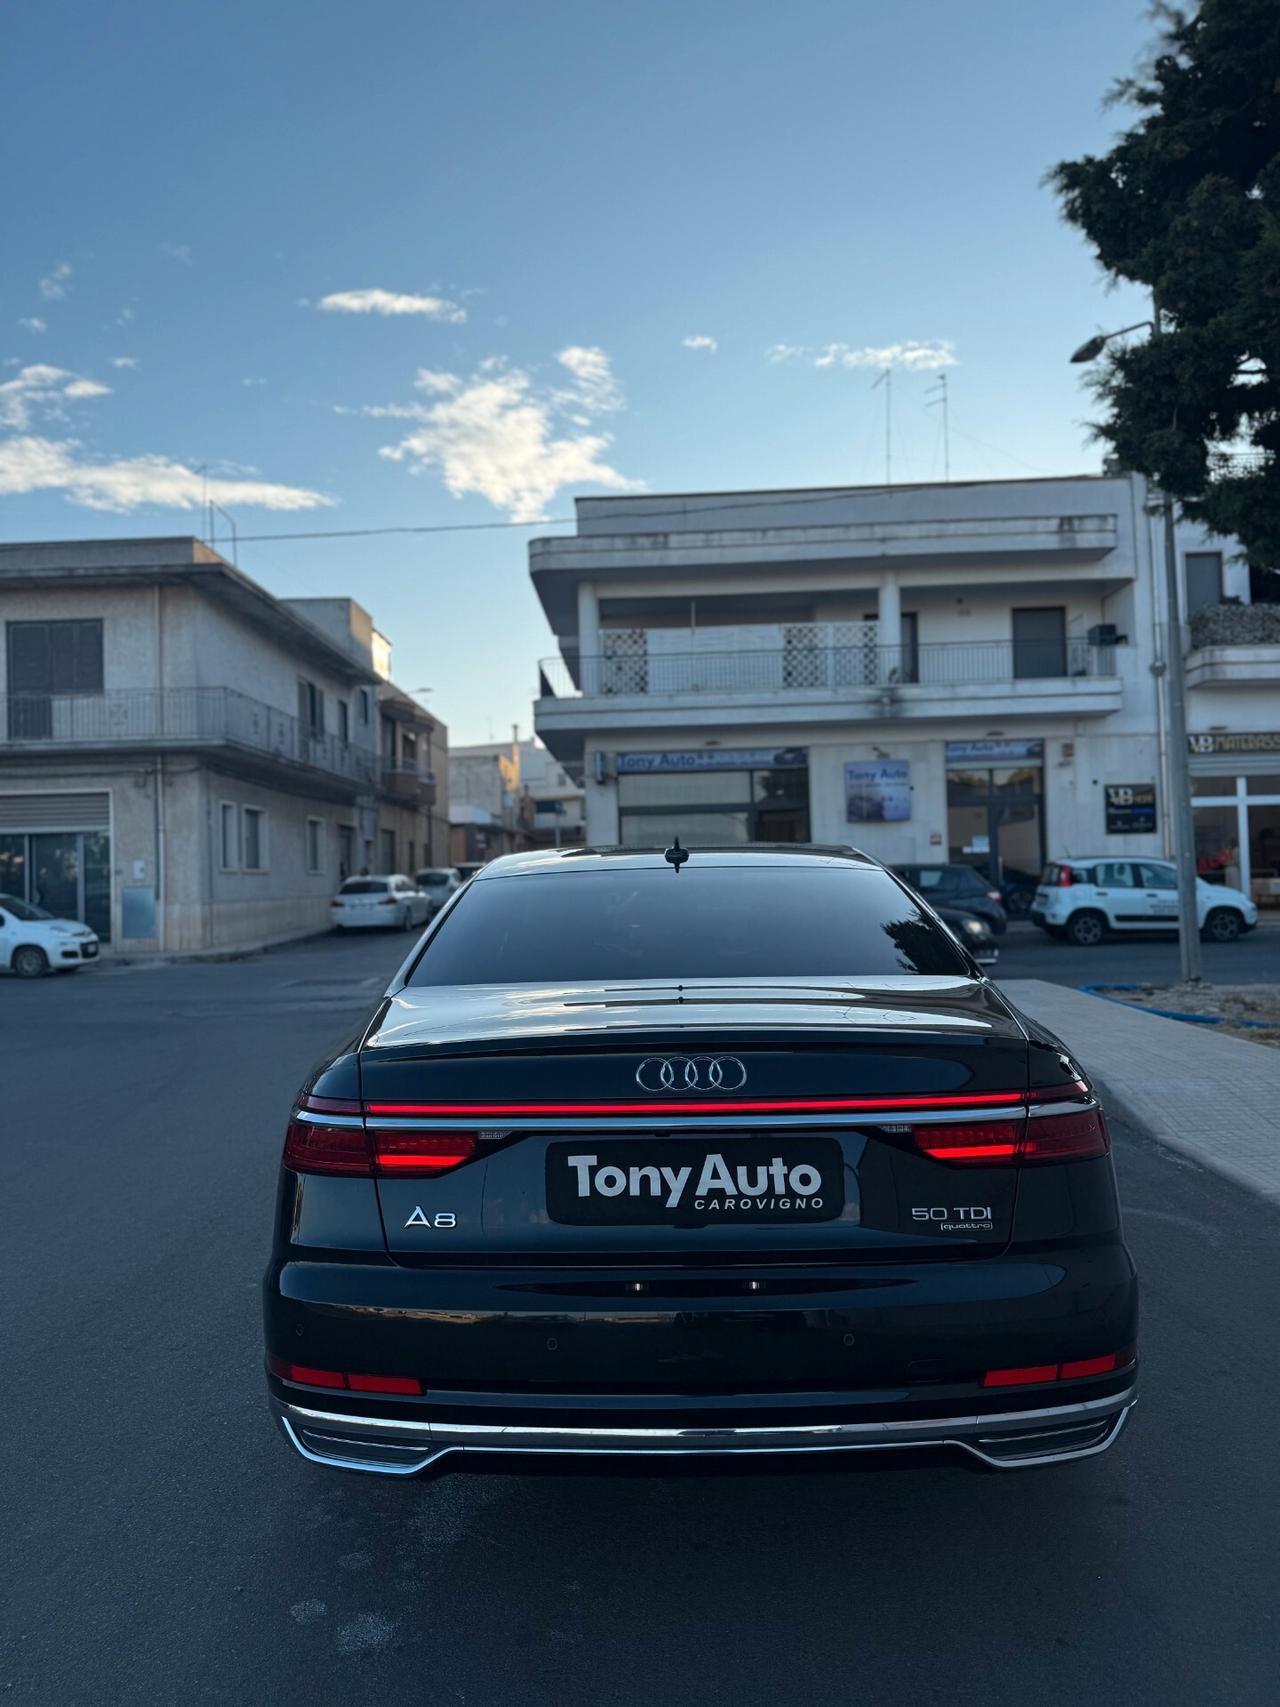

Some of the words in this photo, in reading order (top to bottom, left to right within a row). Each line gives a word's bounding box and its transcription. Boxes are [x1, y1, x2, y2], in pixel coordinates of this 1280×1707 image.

[619, 753, 655, 769] Tony
[660, 753, 696, 767] Auto
[694, 1197, 824, 1210] CAROVIGNO
[403, 1205, 456, 1229] A8
[911, 1207, 948, 1220] 50
[953, 1206, 992, 1220] TDI
[943, 1222, 991, 1231] quattro
